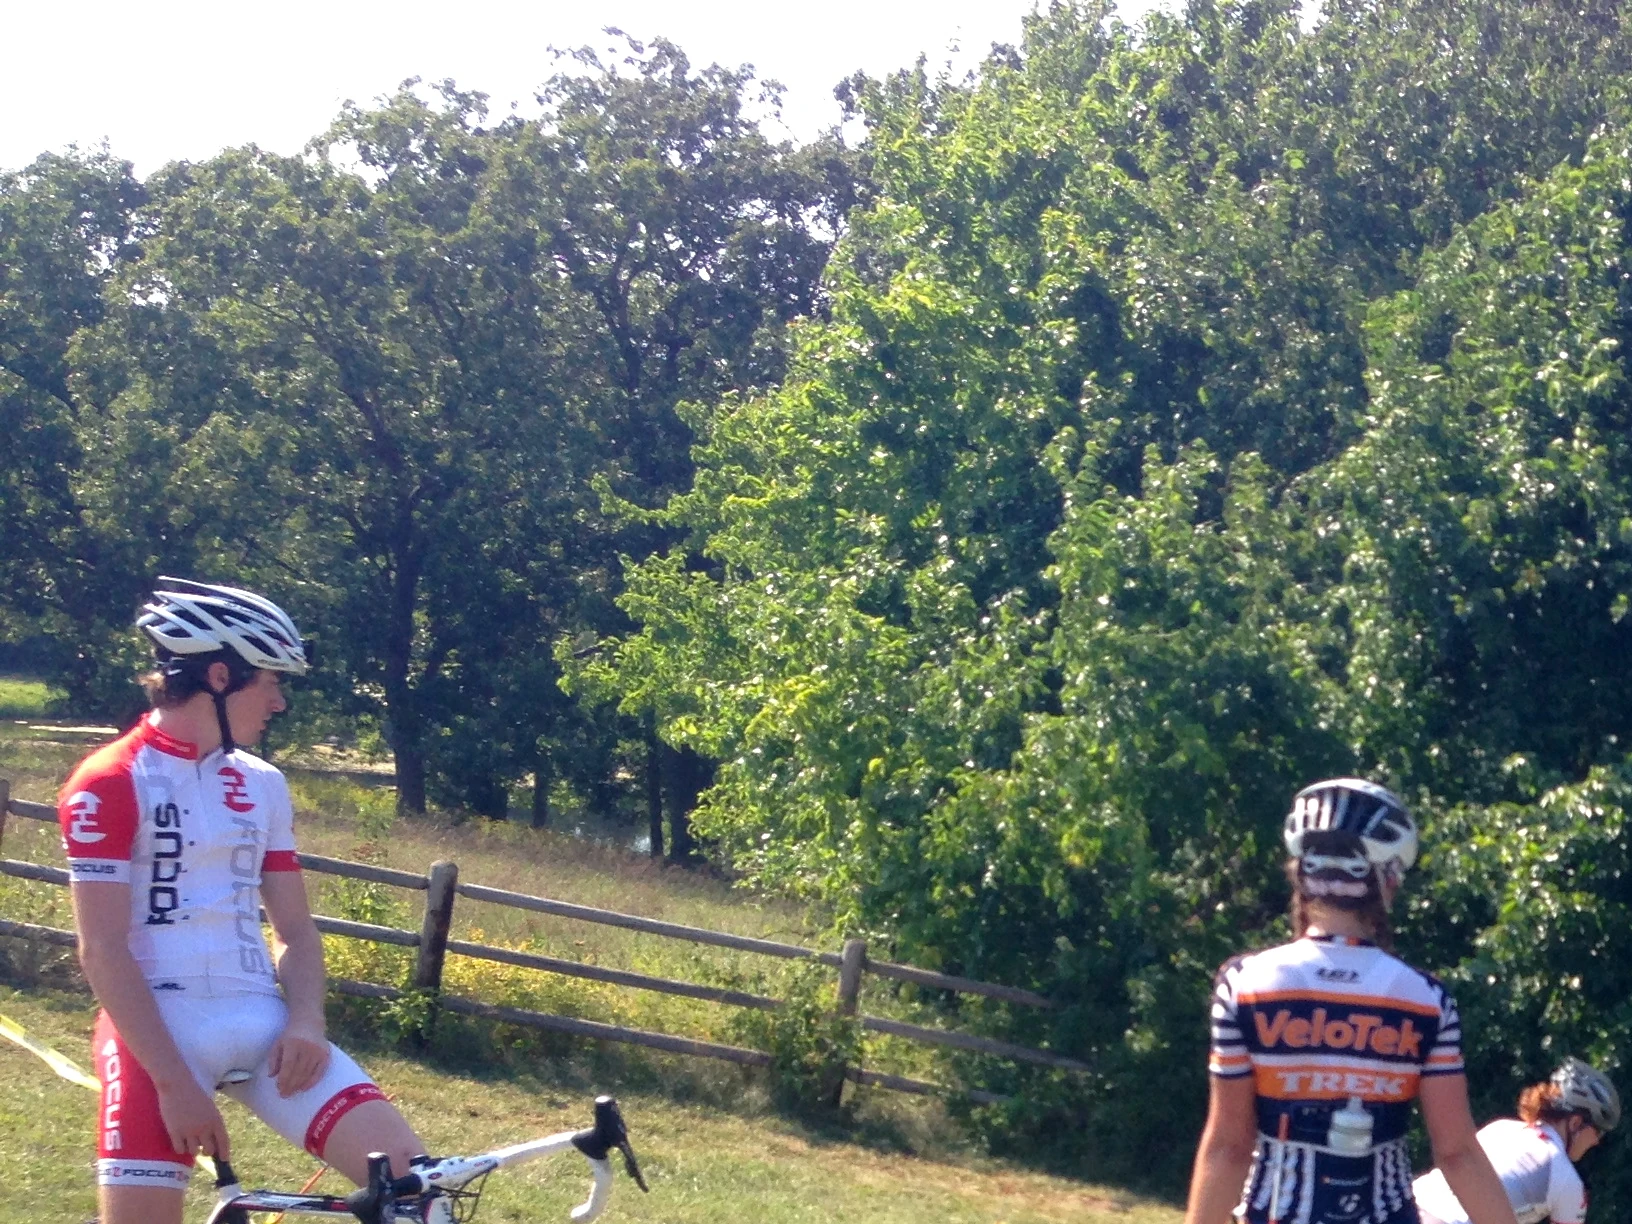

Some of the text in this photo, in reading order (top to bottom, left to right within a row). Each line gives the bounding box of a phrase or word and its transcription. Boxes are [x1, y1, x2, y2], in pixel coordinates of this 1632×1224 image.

[70, 864, 117, 874] OCUS
[146, 802, 183, 925] FOCUS
[1254, 1008, 1422, 1057] VeloTek
[1277, 1072, 1408, 1095] TREK
[122, 1167, 176, 1179] FOCUS
